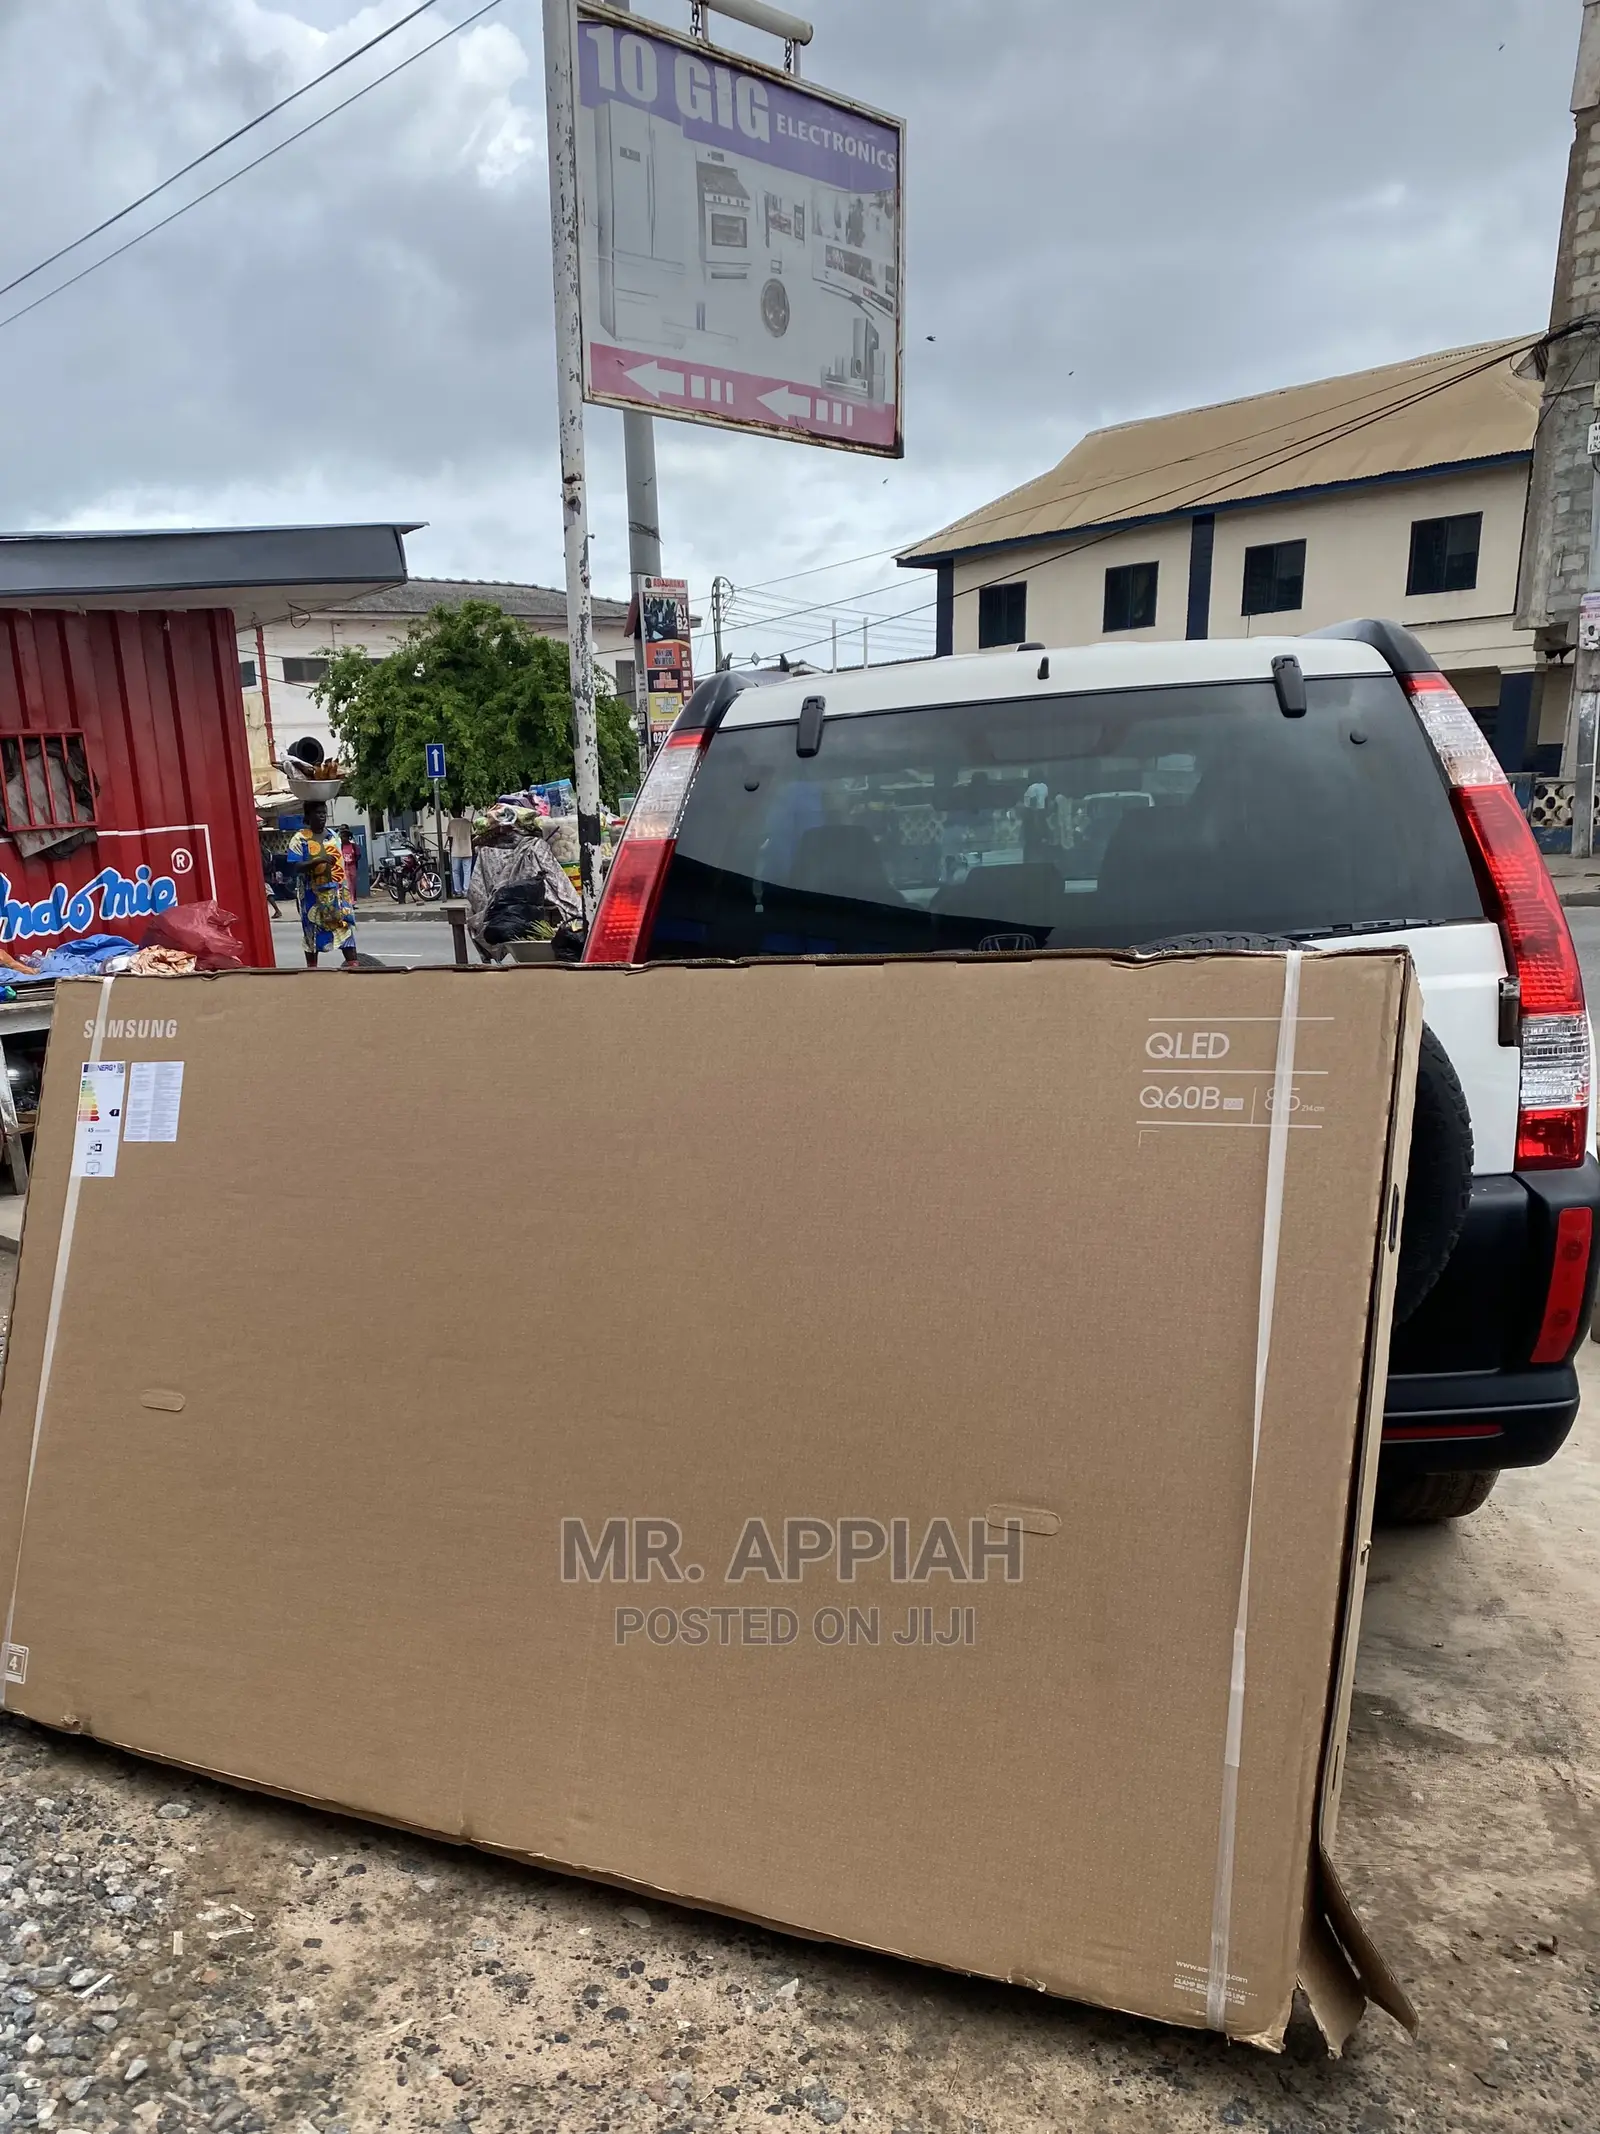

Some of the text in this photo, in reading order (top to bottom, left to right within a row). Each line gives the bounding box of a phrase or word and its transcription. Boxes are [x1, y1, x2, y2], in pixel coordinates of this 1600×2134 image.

[586, 25, 897, 173] 10 GIG ELECTRONICS
[83, 1019, 178, 1039] SMSUNG
[1145, 1031, 1230, 1059] QLED
[1139, 1085, 1221, 1110] Q60B
[8, 1655, 18, 1671] 4
